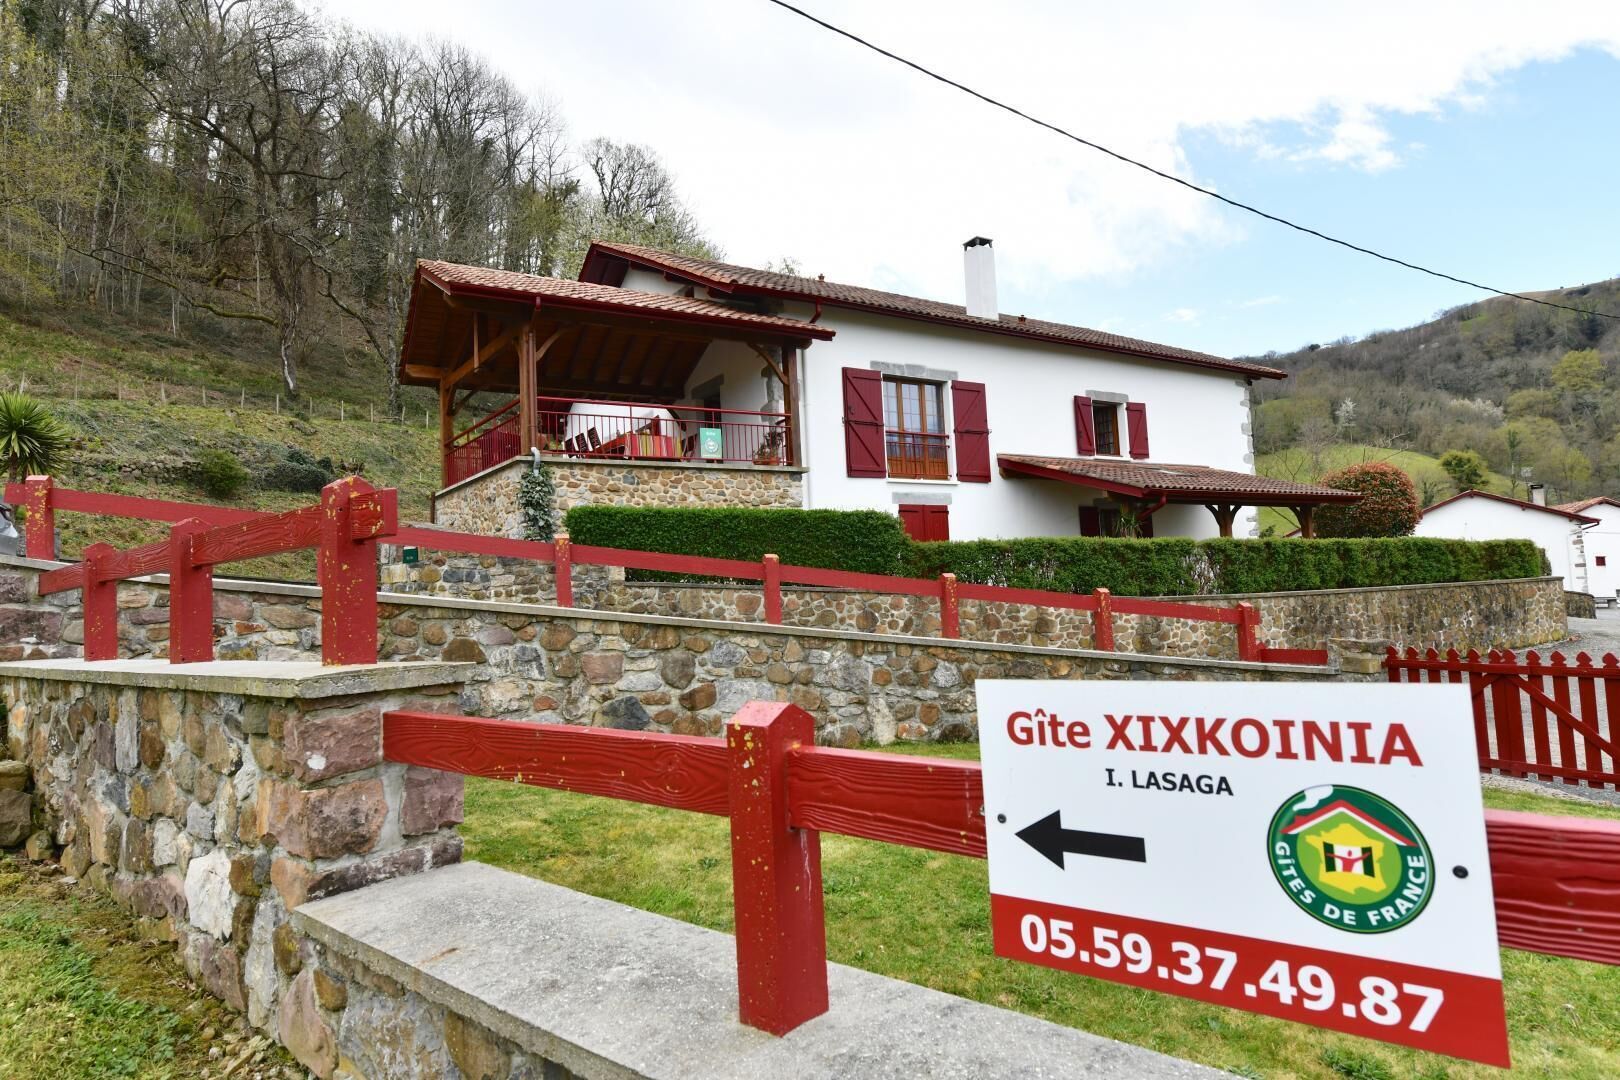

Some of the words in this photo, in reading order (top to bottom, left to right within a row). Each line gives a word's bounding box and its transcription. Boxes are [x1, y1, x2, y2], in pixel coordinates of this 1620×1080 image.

[1006, 708, 1092, 749] Gîte
[1103, 714, 1424, 768] XIXKOINIA
[1105, 768, 1123, 787] I.
[1131, 770, 1234, 796] LASAGA
[1323, 903, 1357, 926] DE
[1367, 855, 1426, 926] FRANCE
[1020, 914, 1445, 1033] 05.59.37.49.87
